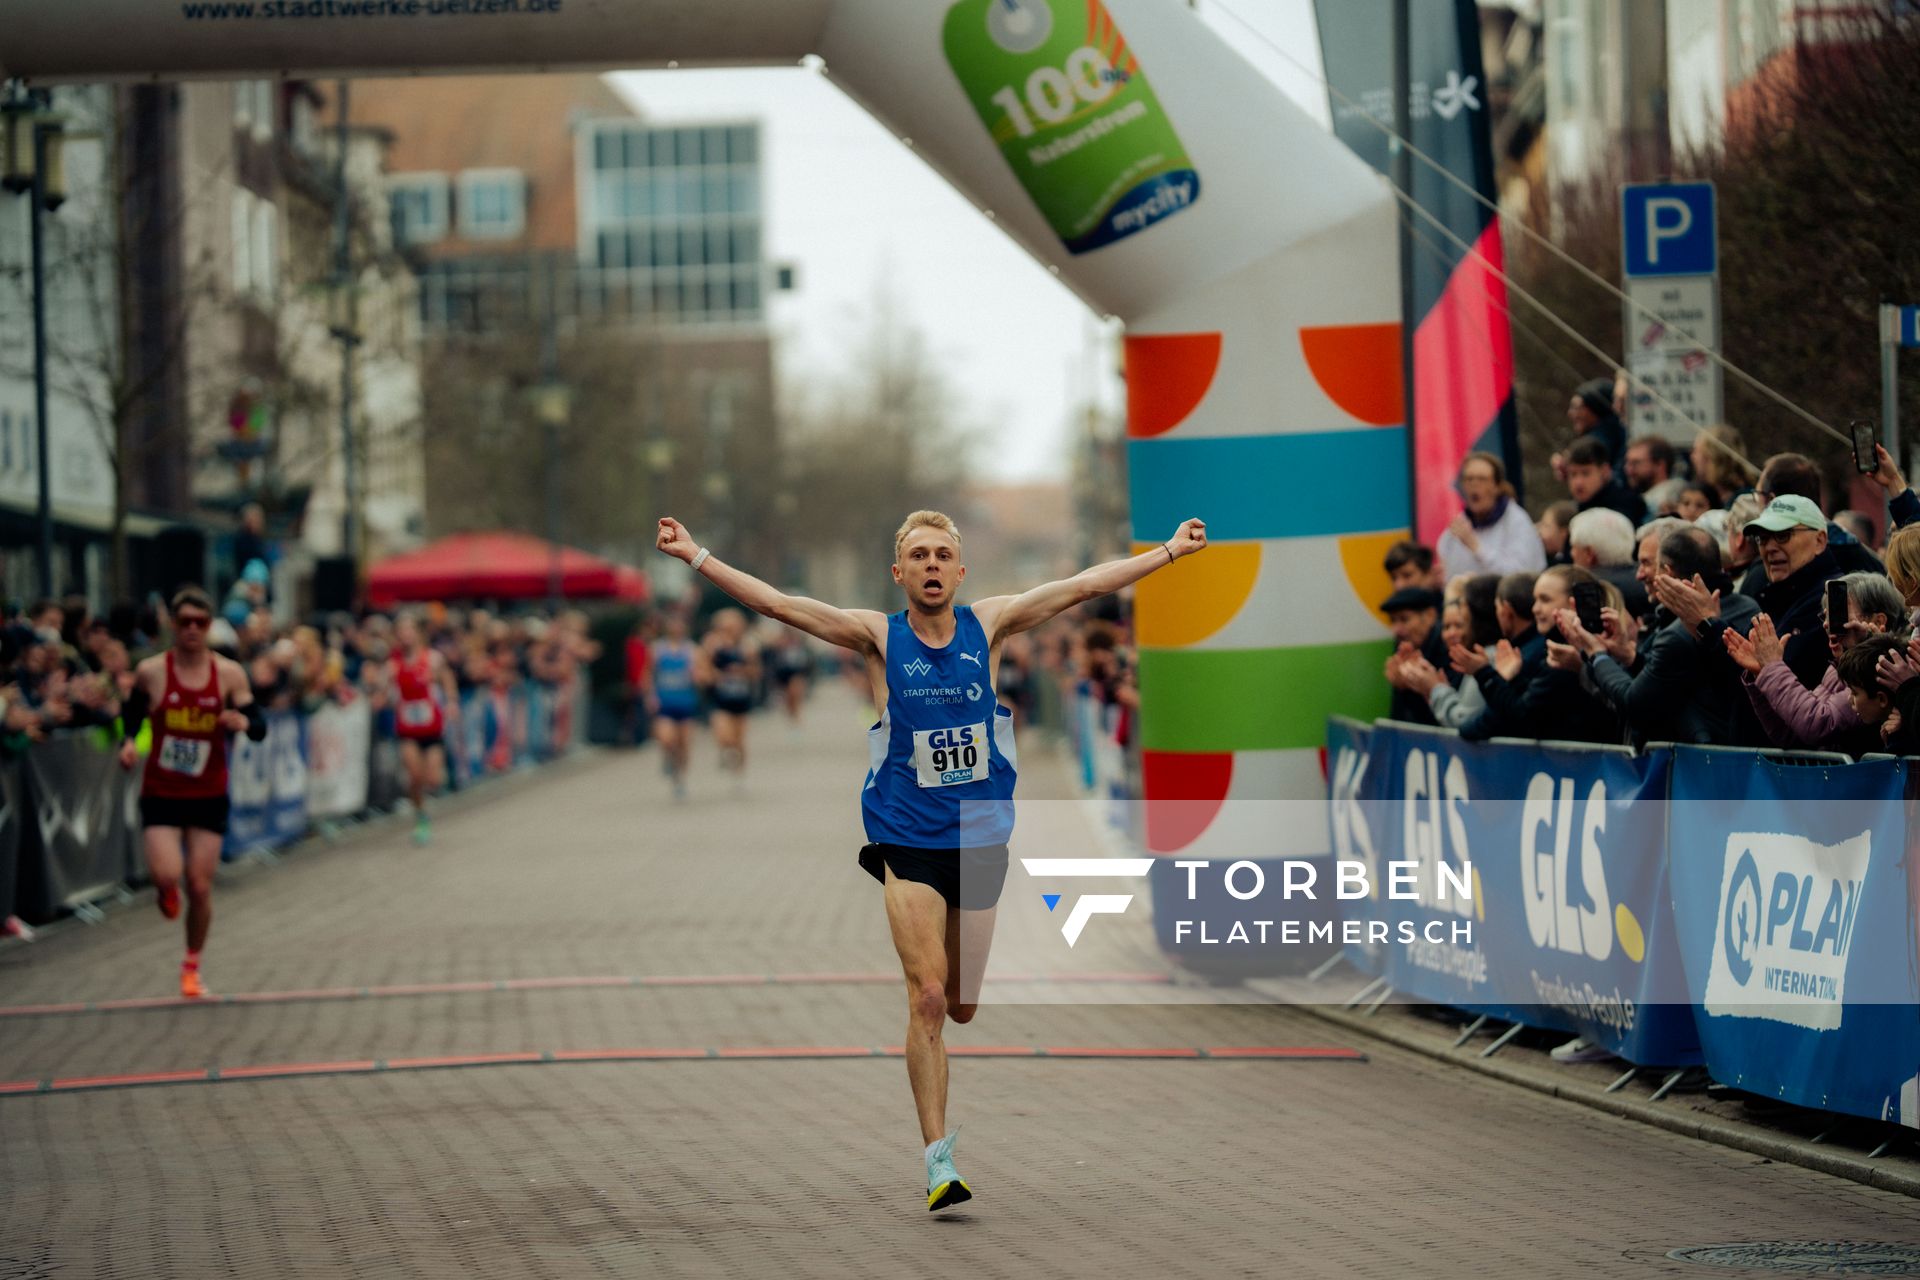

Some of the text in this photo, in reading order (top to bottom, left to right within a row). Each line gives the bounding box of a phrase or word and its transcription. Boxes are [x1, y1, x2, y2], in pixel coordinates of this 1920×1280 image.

[1028, 99, 1149, 166] Naturstrom
[1111, 180, 1194, 232] mycity
[1646, 198, 1692, 263] P
[903, 686, 963, 698] STADTWERKE
[925, 695, 964, 706] BOCHUM
[932, 745, 978, 772] 910
[954, 770, 972, 779] PLAN
[1766, 871, 1862, 958] PLAN
[1583, 981, 1636, 1041] People
